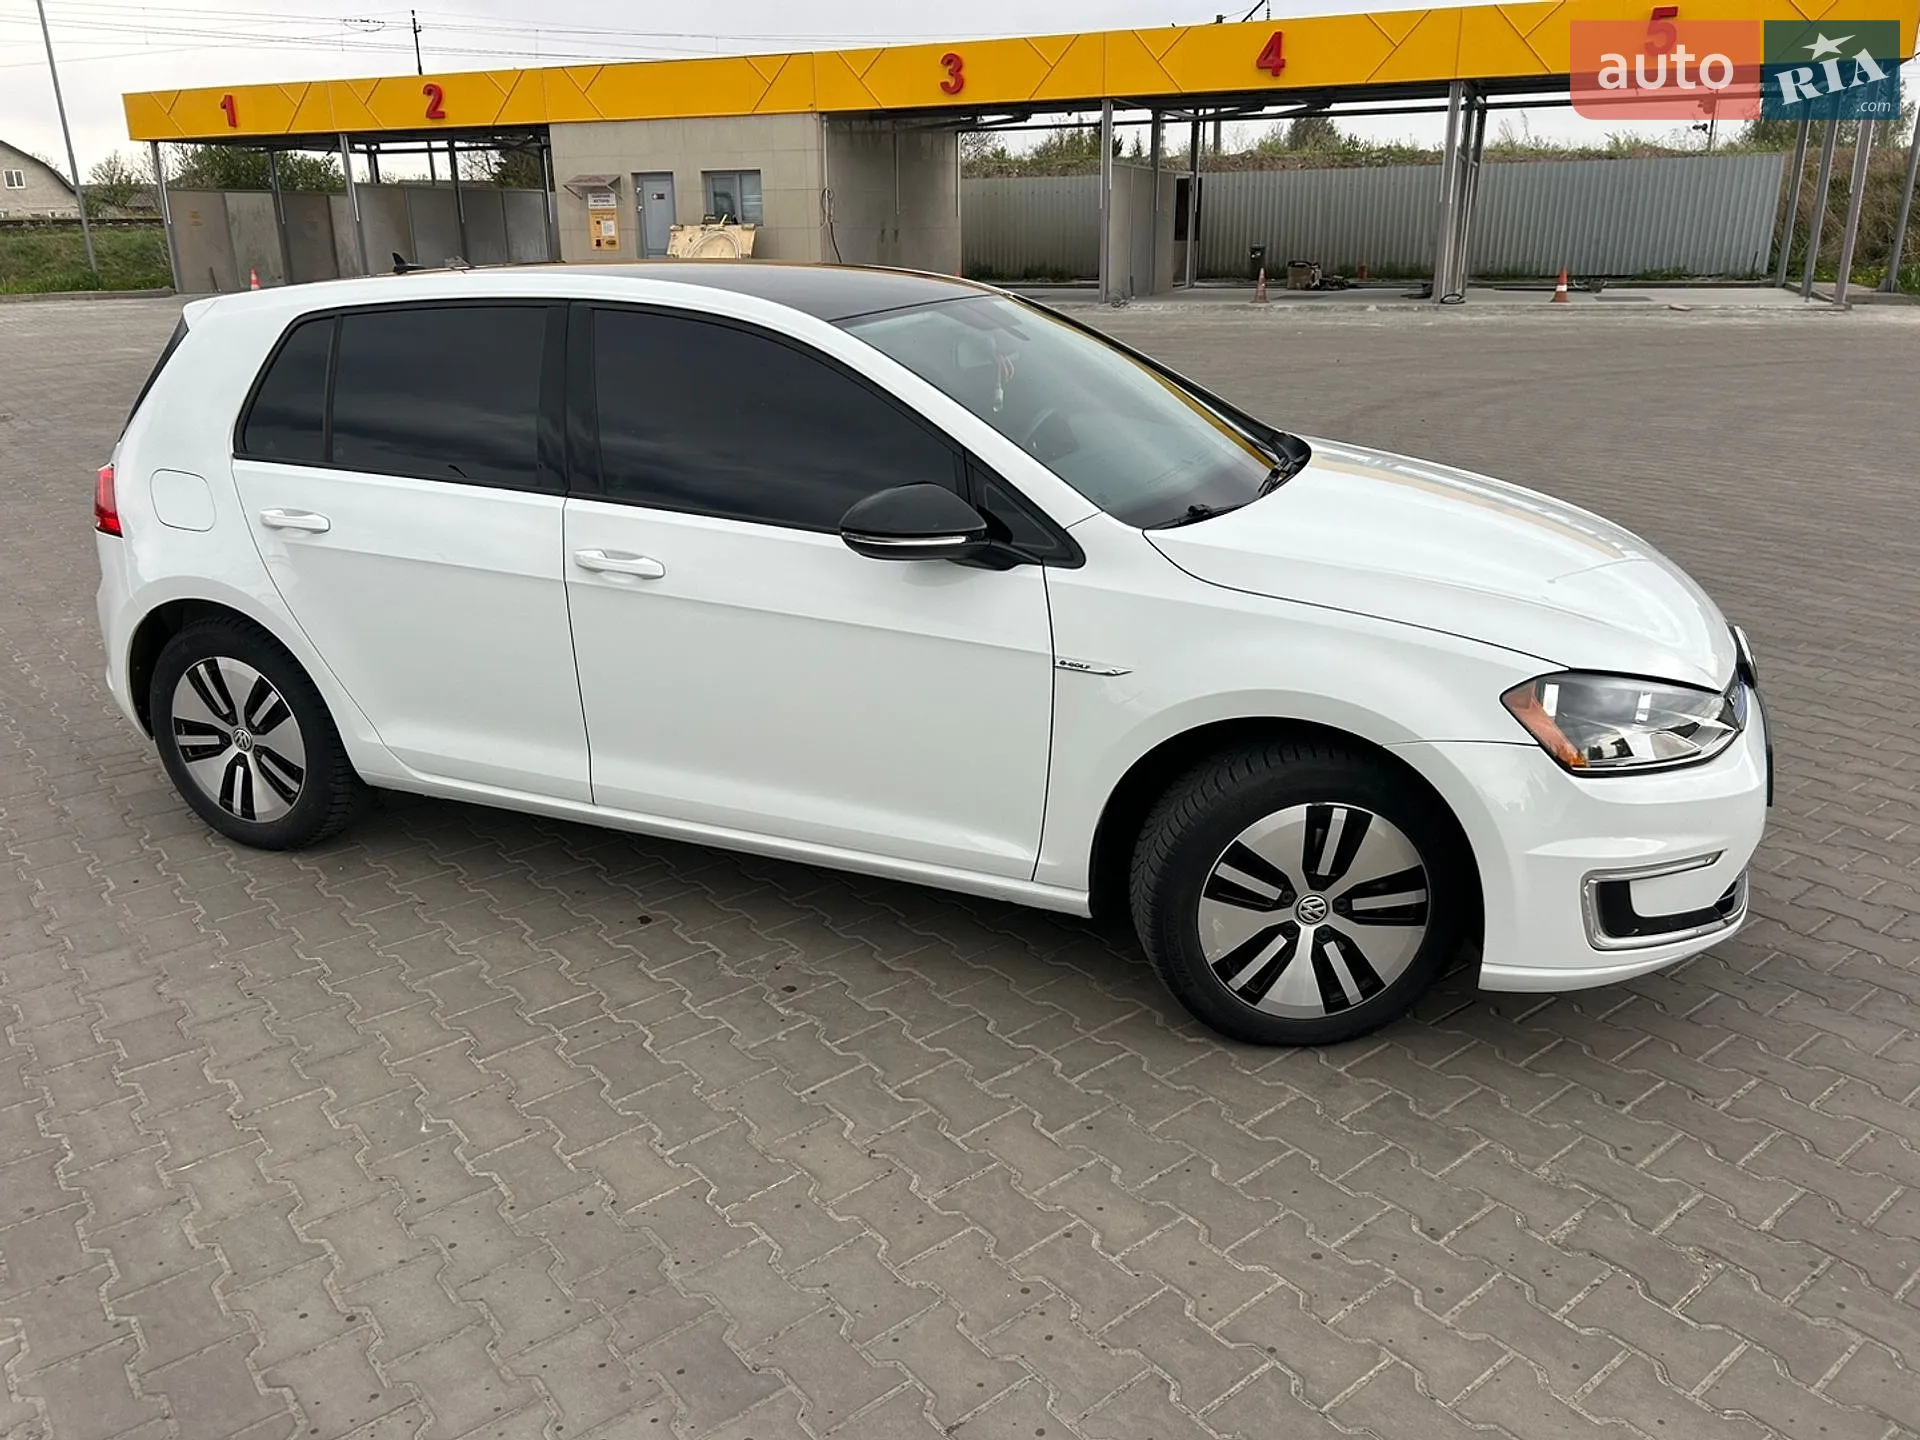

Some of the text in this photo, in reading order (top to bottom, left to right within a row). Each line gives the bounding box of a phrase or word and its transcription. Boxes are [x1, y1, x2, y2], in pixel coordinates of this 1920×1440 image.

[1644, 6, 1679, 56] 5
[940, 53, 964, 95] 3
[1255, 31, 1285, 77] 4
[220, 94, 237, 128] 1
[422, 83, 446, 119] 2
